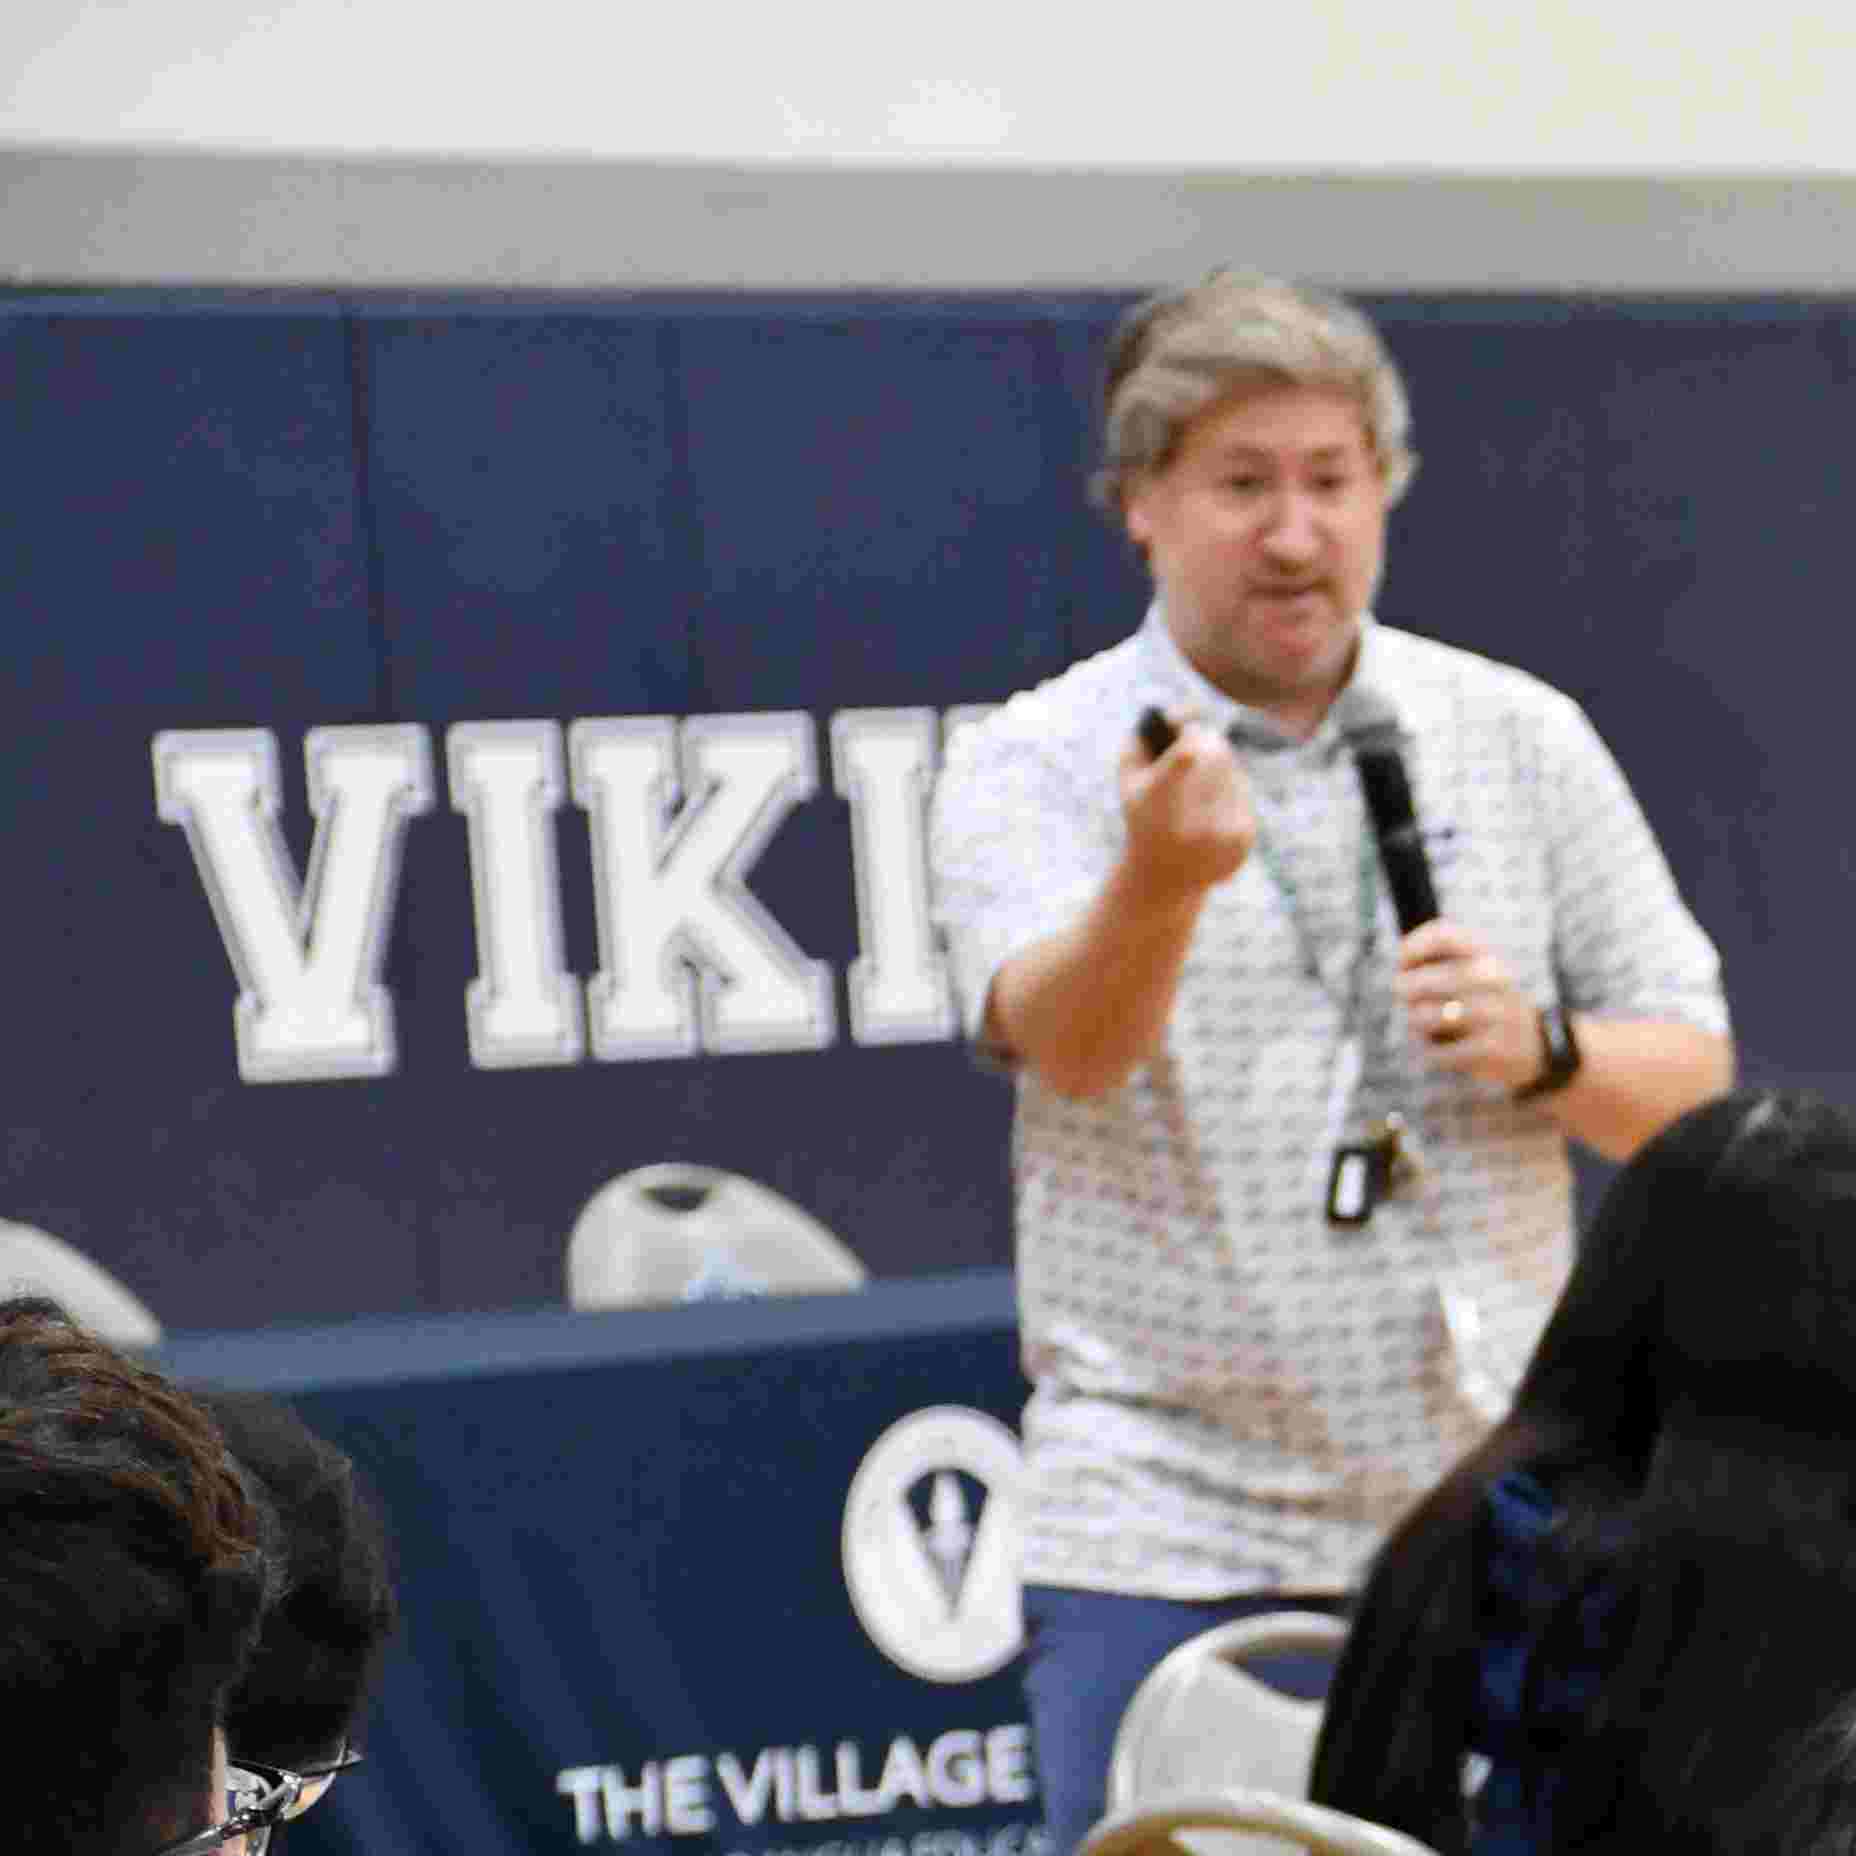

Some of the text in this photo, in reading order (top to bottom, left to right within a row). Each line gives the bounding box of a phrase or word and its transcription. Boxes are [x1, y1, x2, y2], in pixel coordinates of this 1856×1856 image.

[150, 702, 1000, 1085] VIKI
[556, 1721, 1036, 1846] THE VILLAGE
